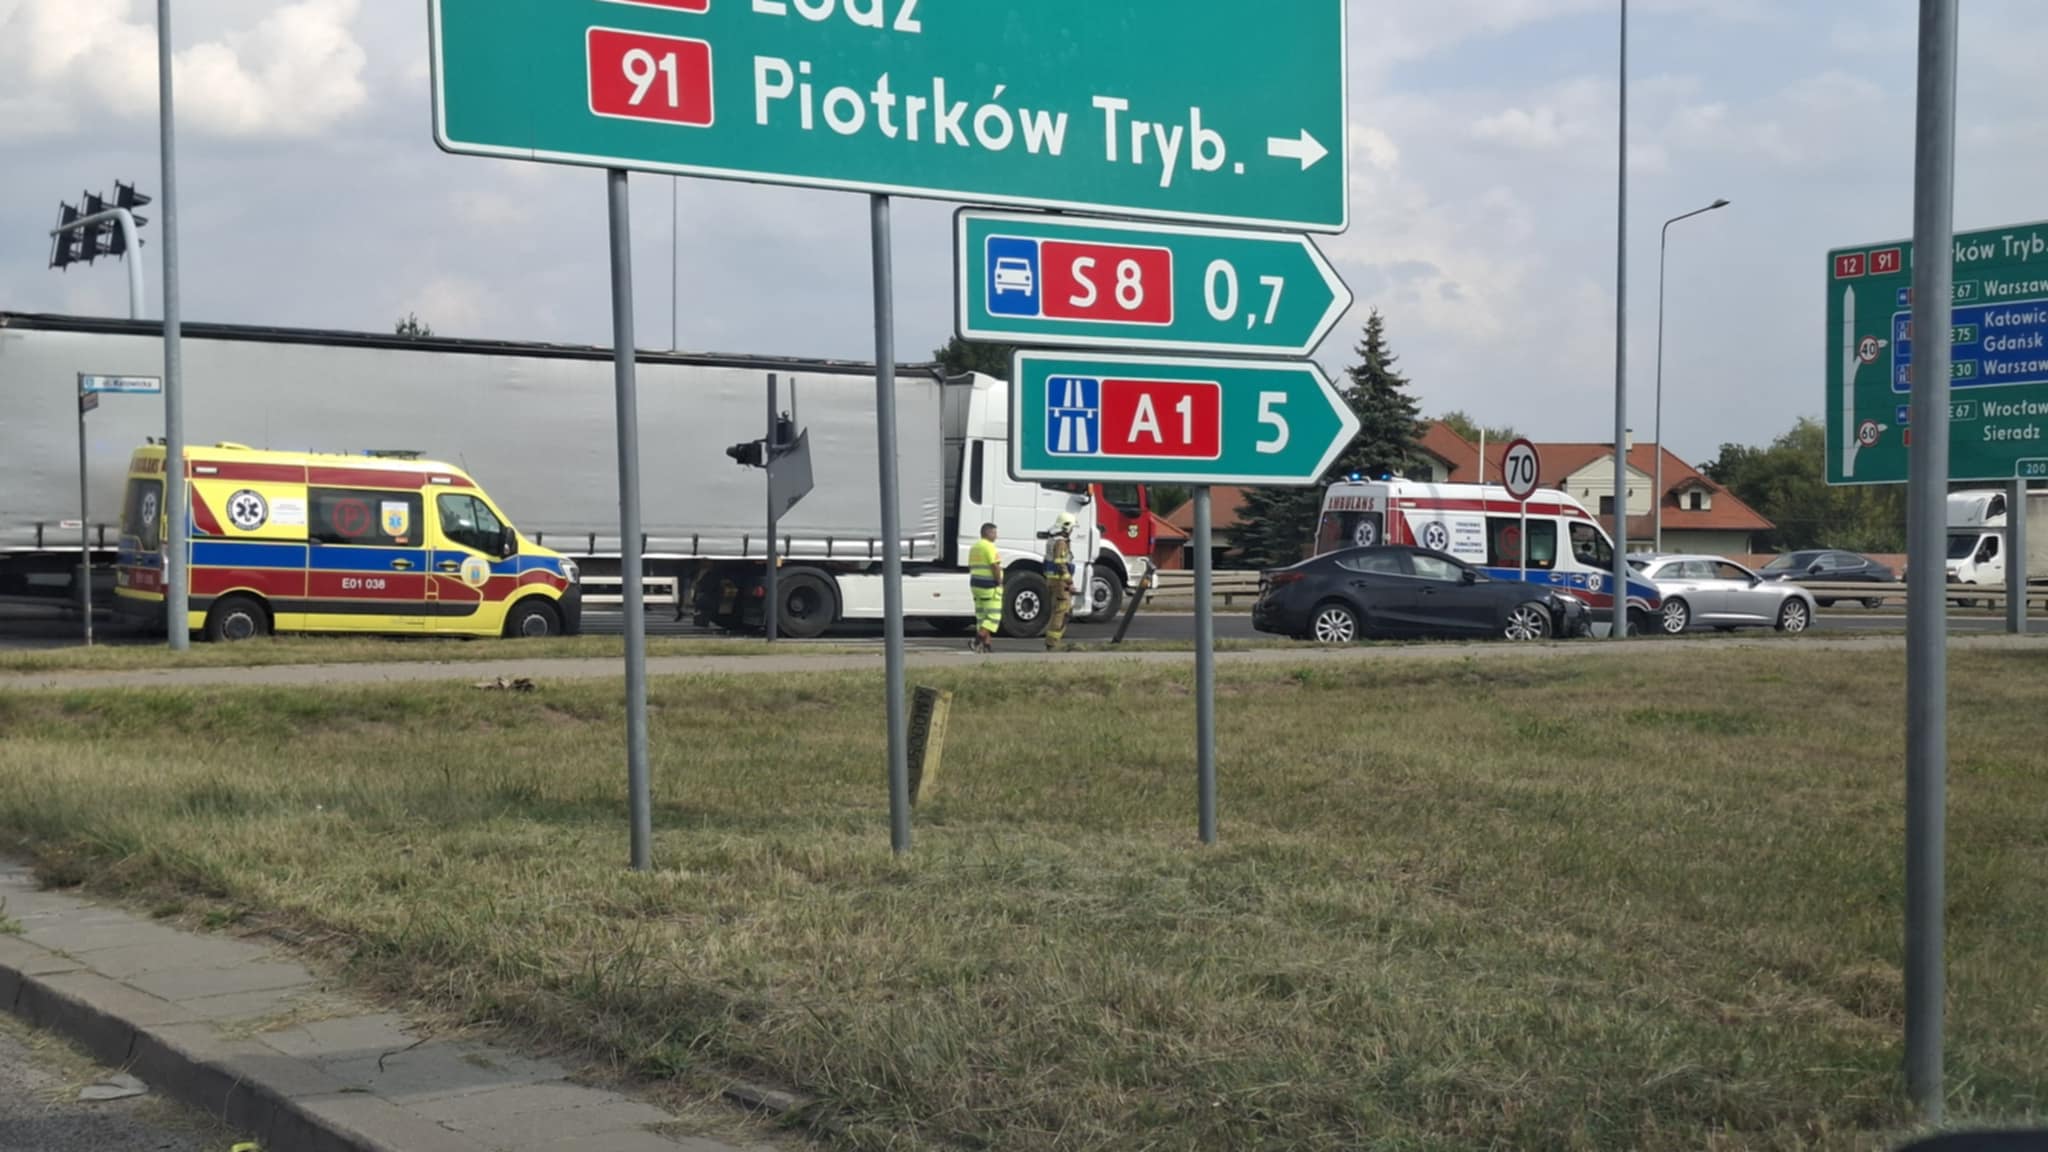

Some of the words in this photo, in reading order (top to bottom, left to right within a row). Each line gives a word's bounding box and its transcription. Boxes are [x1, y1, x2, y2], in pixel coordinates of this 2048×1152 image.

[622, 48, 678, 107] 91
[754, 56, 1068, 156] Piotrków
[1092, 95, 1244, 187] Tryb.
[1843, 257, 1857, 274] 12
[1878, 252, 1892, 270] 91
[1204, 259, 1284, 330] 0,7
[1862, 343, 1876, 355] 40
[1984, 332, 2043, 351] Gdańsk
[1956, 363, 1971, 376] 30
[1256, 391, 1289, 454] 5
[1862, 427, 1875, 440] 60
[1983, 424, 2040, 441] Sieradz
[1509, 455, 1534, 485] 70
[342, 578, 361, 590] E01
